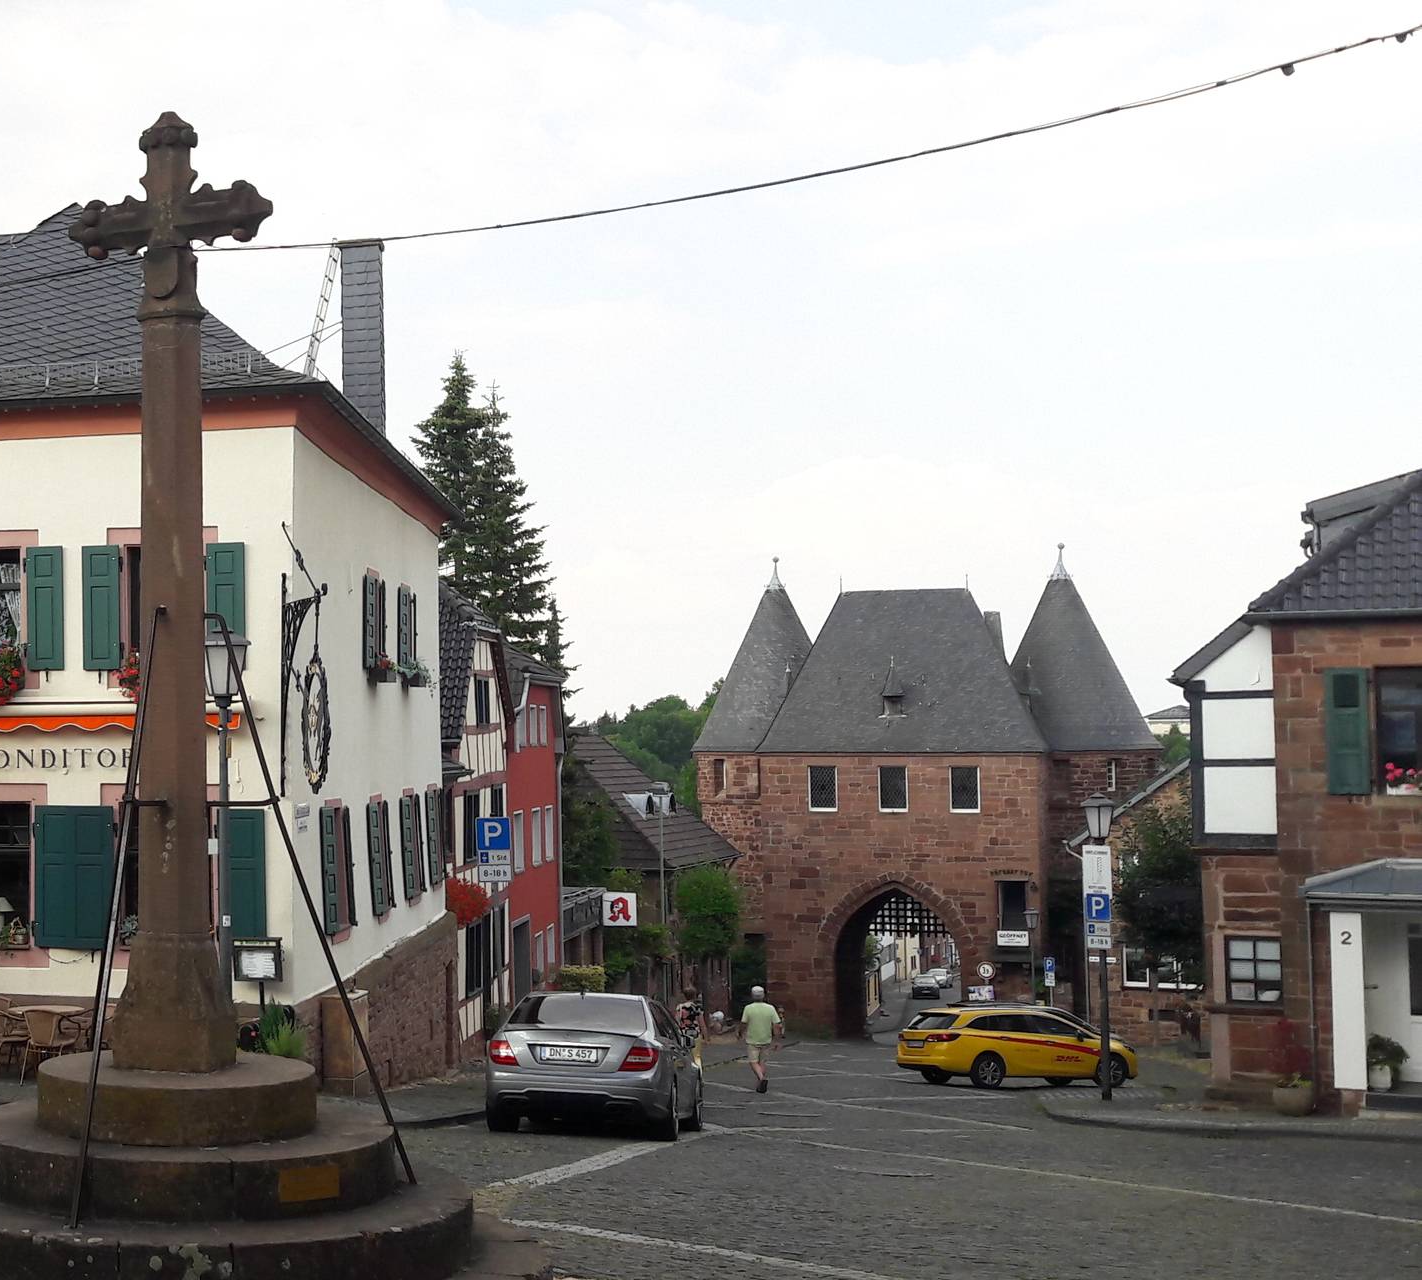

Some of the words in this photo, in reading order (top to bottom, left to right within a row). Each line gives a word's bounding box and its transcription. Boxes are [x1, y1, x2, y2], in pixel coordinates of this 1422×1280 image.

[483, 821, 502, 848] P
[1091, 896, 1105, 918] P
[1340, 930, 1352, 945] 2
[1046, 959, 1053, 970] P
[549, 1047, 562, 1057] DN
[567, 1049, 574, 1058] S
[575, 1049, 593, 1059] 457
[1055, 1055, 1081, 1063] DHL
